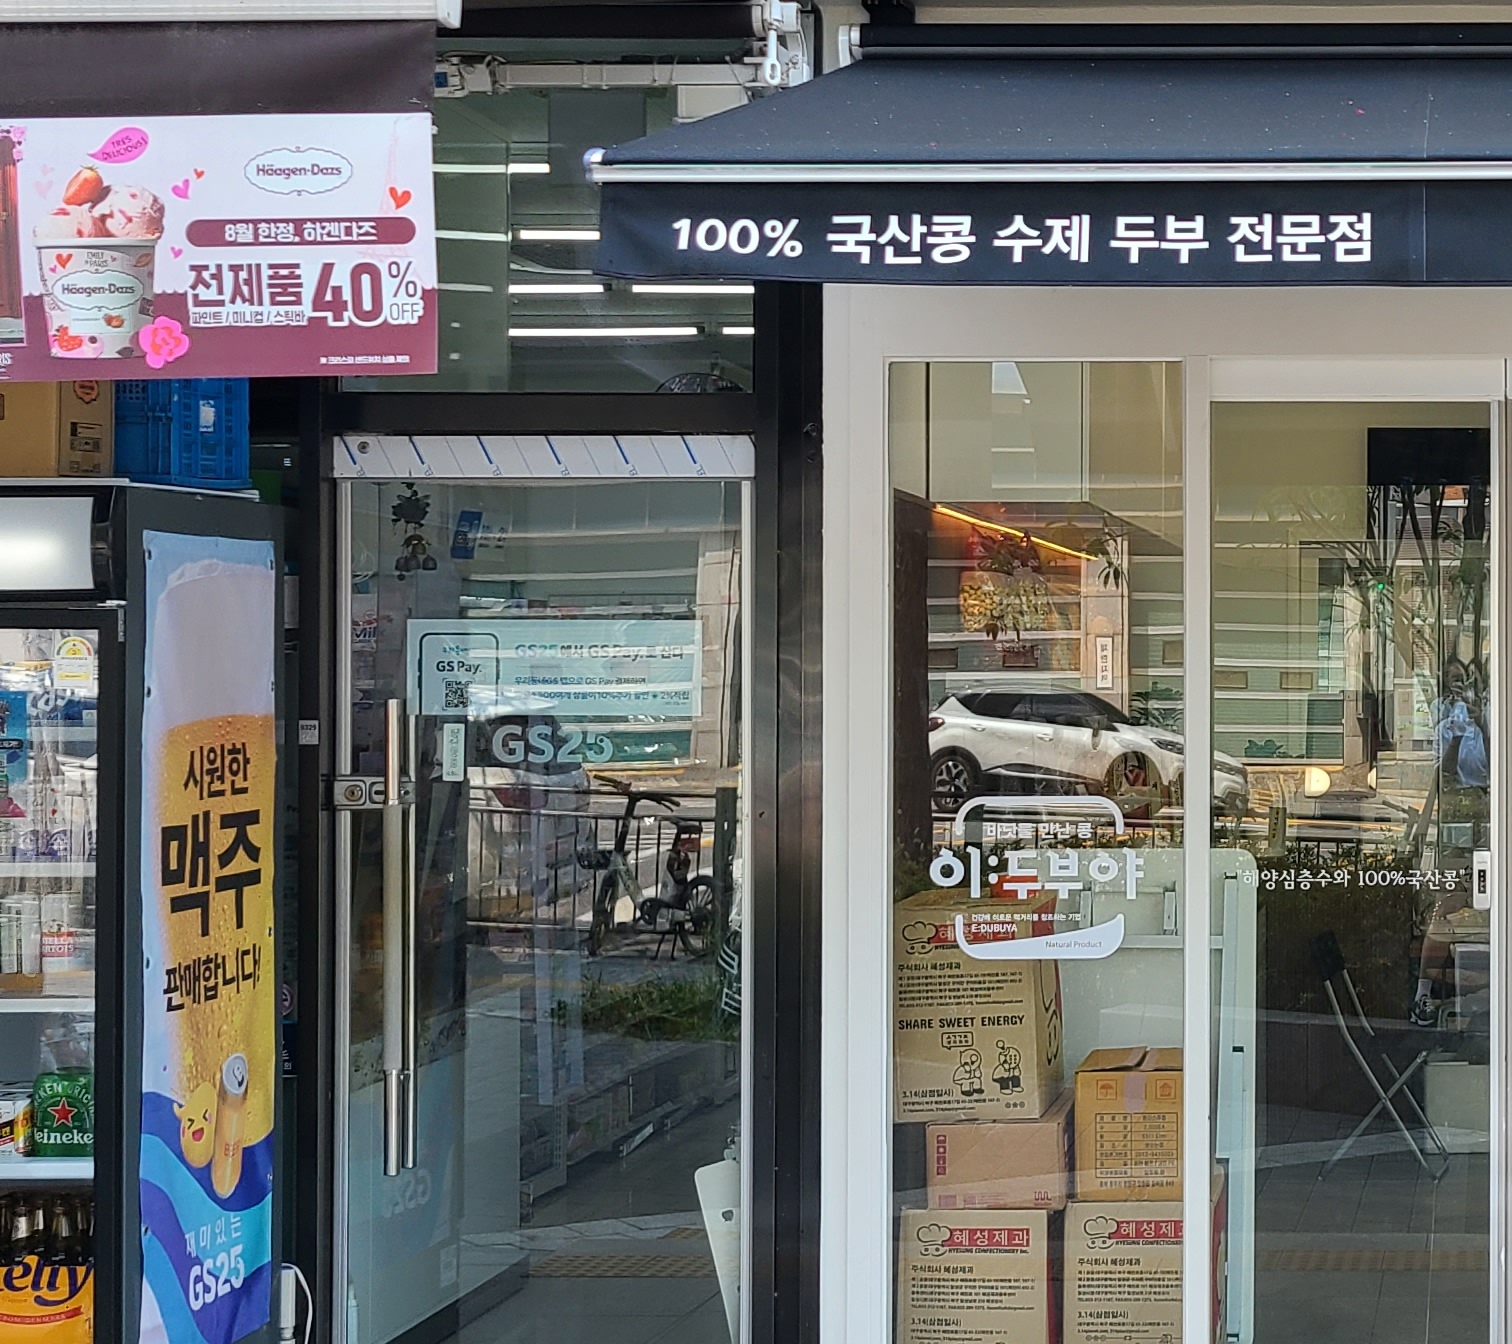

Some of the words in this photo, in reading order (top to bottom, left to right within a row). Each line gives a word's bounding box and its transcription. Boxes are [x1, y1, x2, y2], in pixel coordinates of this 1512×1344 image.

[224, 222, 255, 243] 8월
[257, 222, 300, 244] 한정,
[302, 221, 378, 243] 하겐다즈
[671, 217, 803, 258] 100%
[826, 214, 977, 265] 국산콩
[992, 214, 1090, 264] 수제
[1108, 216, 1210, 263] 두부
[1227, 213, 1373, 263] 전문점
[188, 261, 304, 309] 전제품
[189, 310, 225, 325] 파인트
[230, 310, 265, 324] 미니컵
[273, 310, 307, 324] 스틱바
[389, 305, 421, 322] OFF
[492, 724, 614, 764] GS25
[182, 742, 252, 803] 시원한
[1076, 822, 1094, 839] 콩
[160, 807, 263, 938] 맥주
[928, 845, 1145, 901] 이:두부야
[1045, 940, 1073, 950] Natural
[1073, 940, 1103, 950] Product
[162, 943, 262, 1013] 판매합니다!
[897, 1017, 935, 1030] SHARE
[938, 1016, 977, 1029] SWEET
[980, 1014, 1026, 1027] ENERGY
[184, 1212, 243, 1258] 재미있는
[953, 1229, 1029, 1247] 혜성제과
[910, 1264, 942, 1274] 주식회사
[1077, 1257, 1109, 1267] 주식회사
[188, 1243, 246, 1313] GS25
